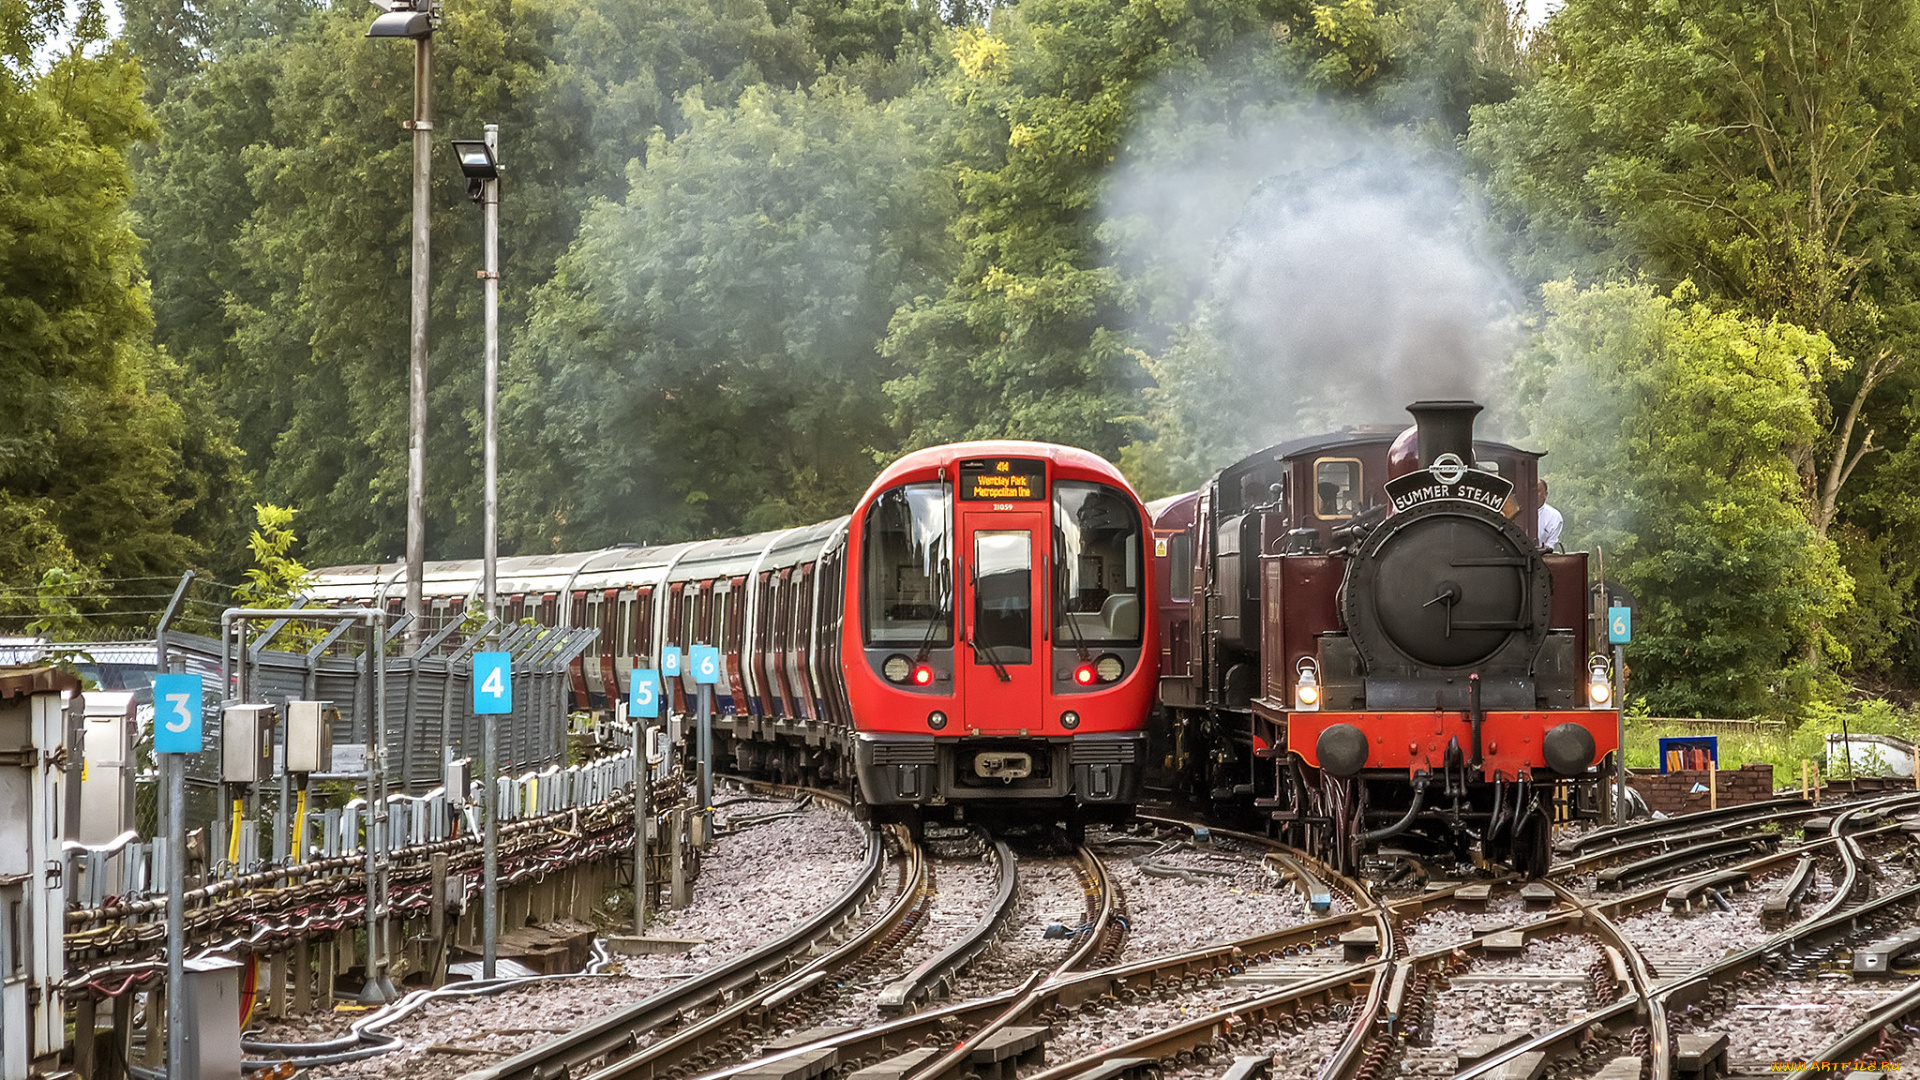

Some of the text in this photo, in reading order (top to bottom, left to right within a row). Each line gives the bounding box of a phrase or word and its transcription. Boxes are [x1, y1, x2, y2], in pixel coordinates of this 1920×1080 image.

[996, 461, 1010, 472] 414
[977, 475, 1027, 488] Wembley Park
[973, 486, 1018, 498] Metropolitan
[1395, 485, 1503, 509] SUMMER STEAM
[1613, 616, 1626, 635] 6
[666, 653, 677, 669] 8
[701, 656, 714, 675] 6
[481, 666, 504, 698] 4
[636, 680, 652, 705] 5
[165, 693, 191, 733] 3
